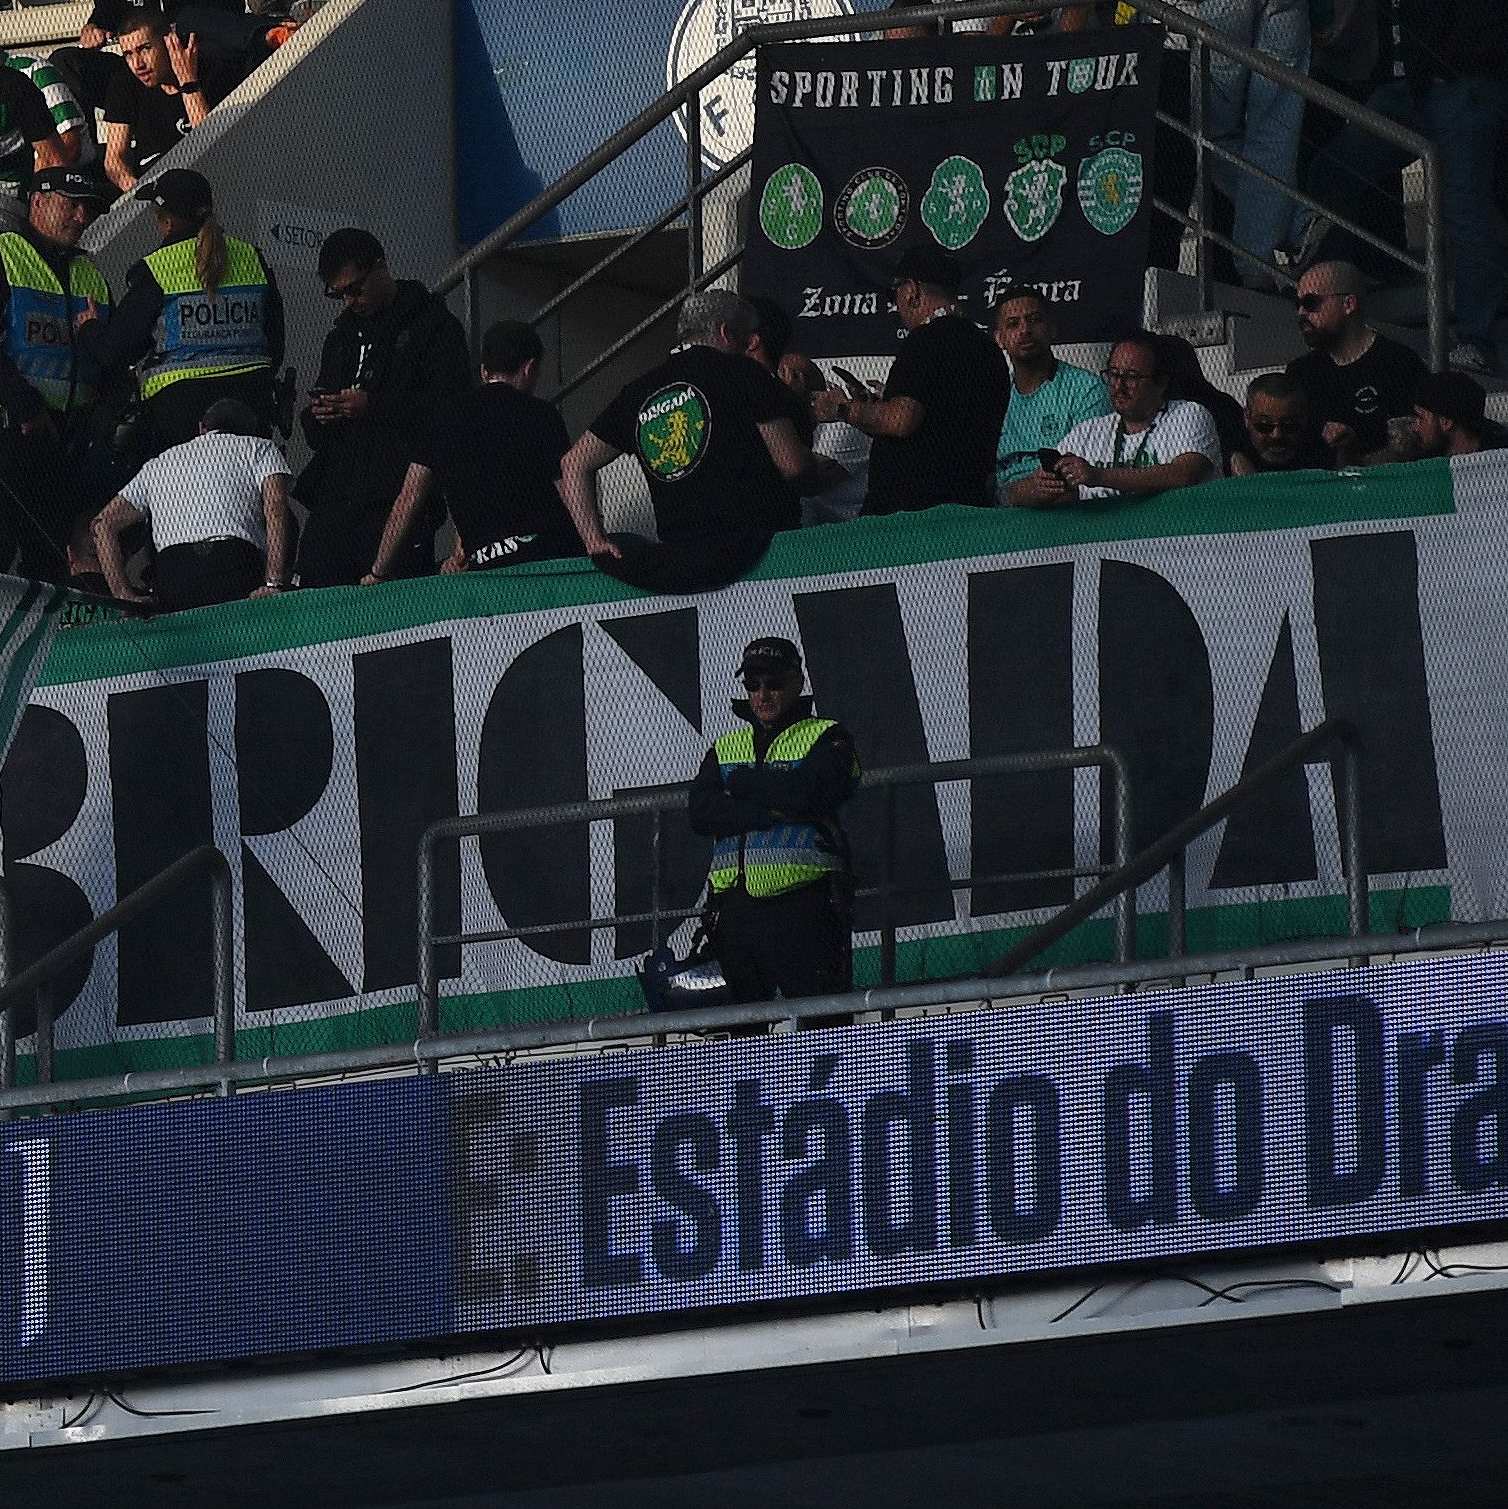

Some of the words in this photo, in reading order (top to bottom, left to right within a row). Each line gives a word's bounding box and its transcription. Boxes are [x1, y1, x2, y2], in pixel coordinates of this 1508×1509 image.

[769, 64, 954, 109] SPORTING
[179, 296, 259, 326] POLÍCIA
[796, 285, 878, 318] Zona
[578, 1037, 1060, 1289] Estádio
[1101, 1011, 1263, 1230] do
